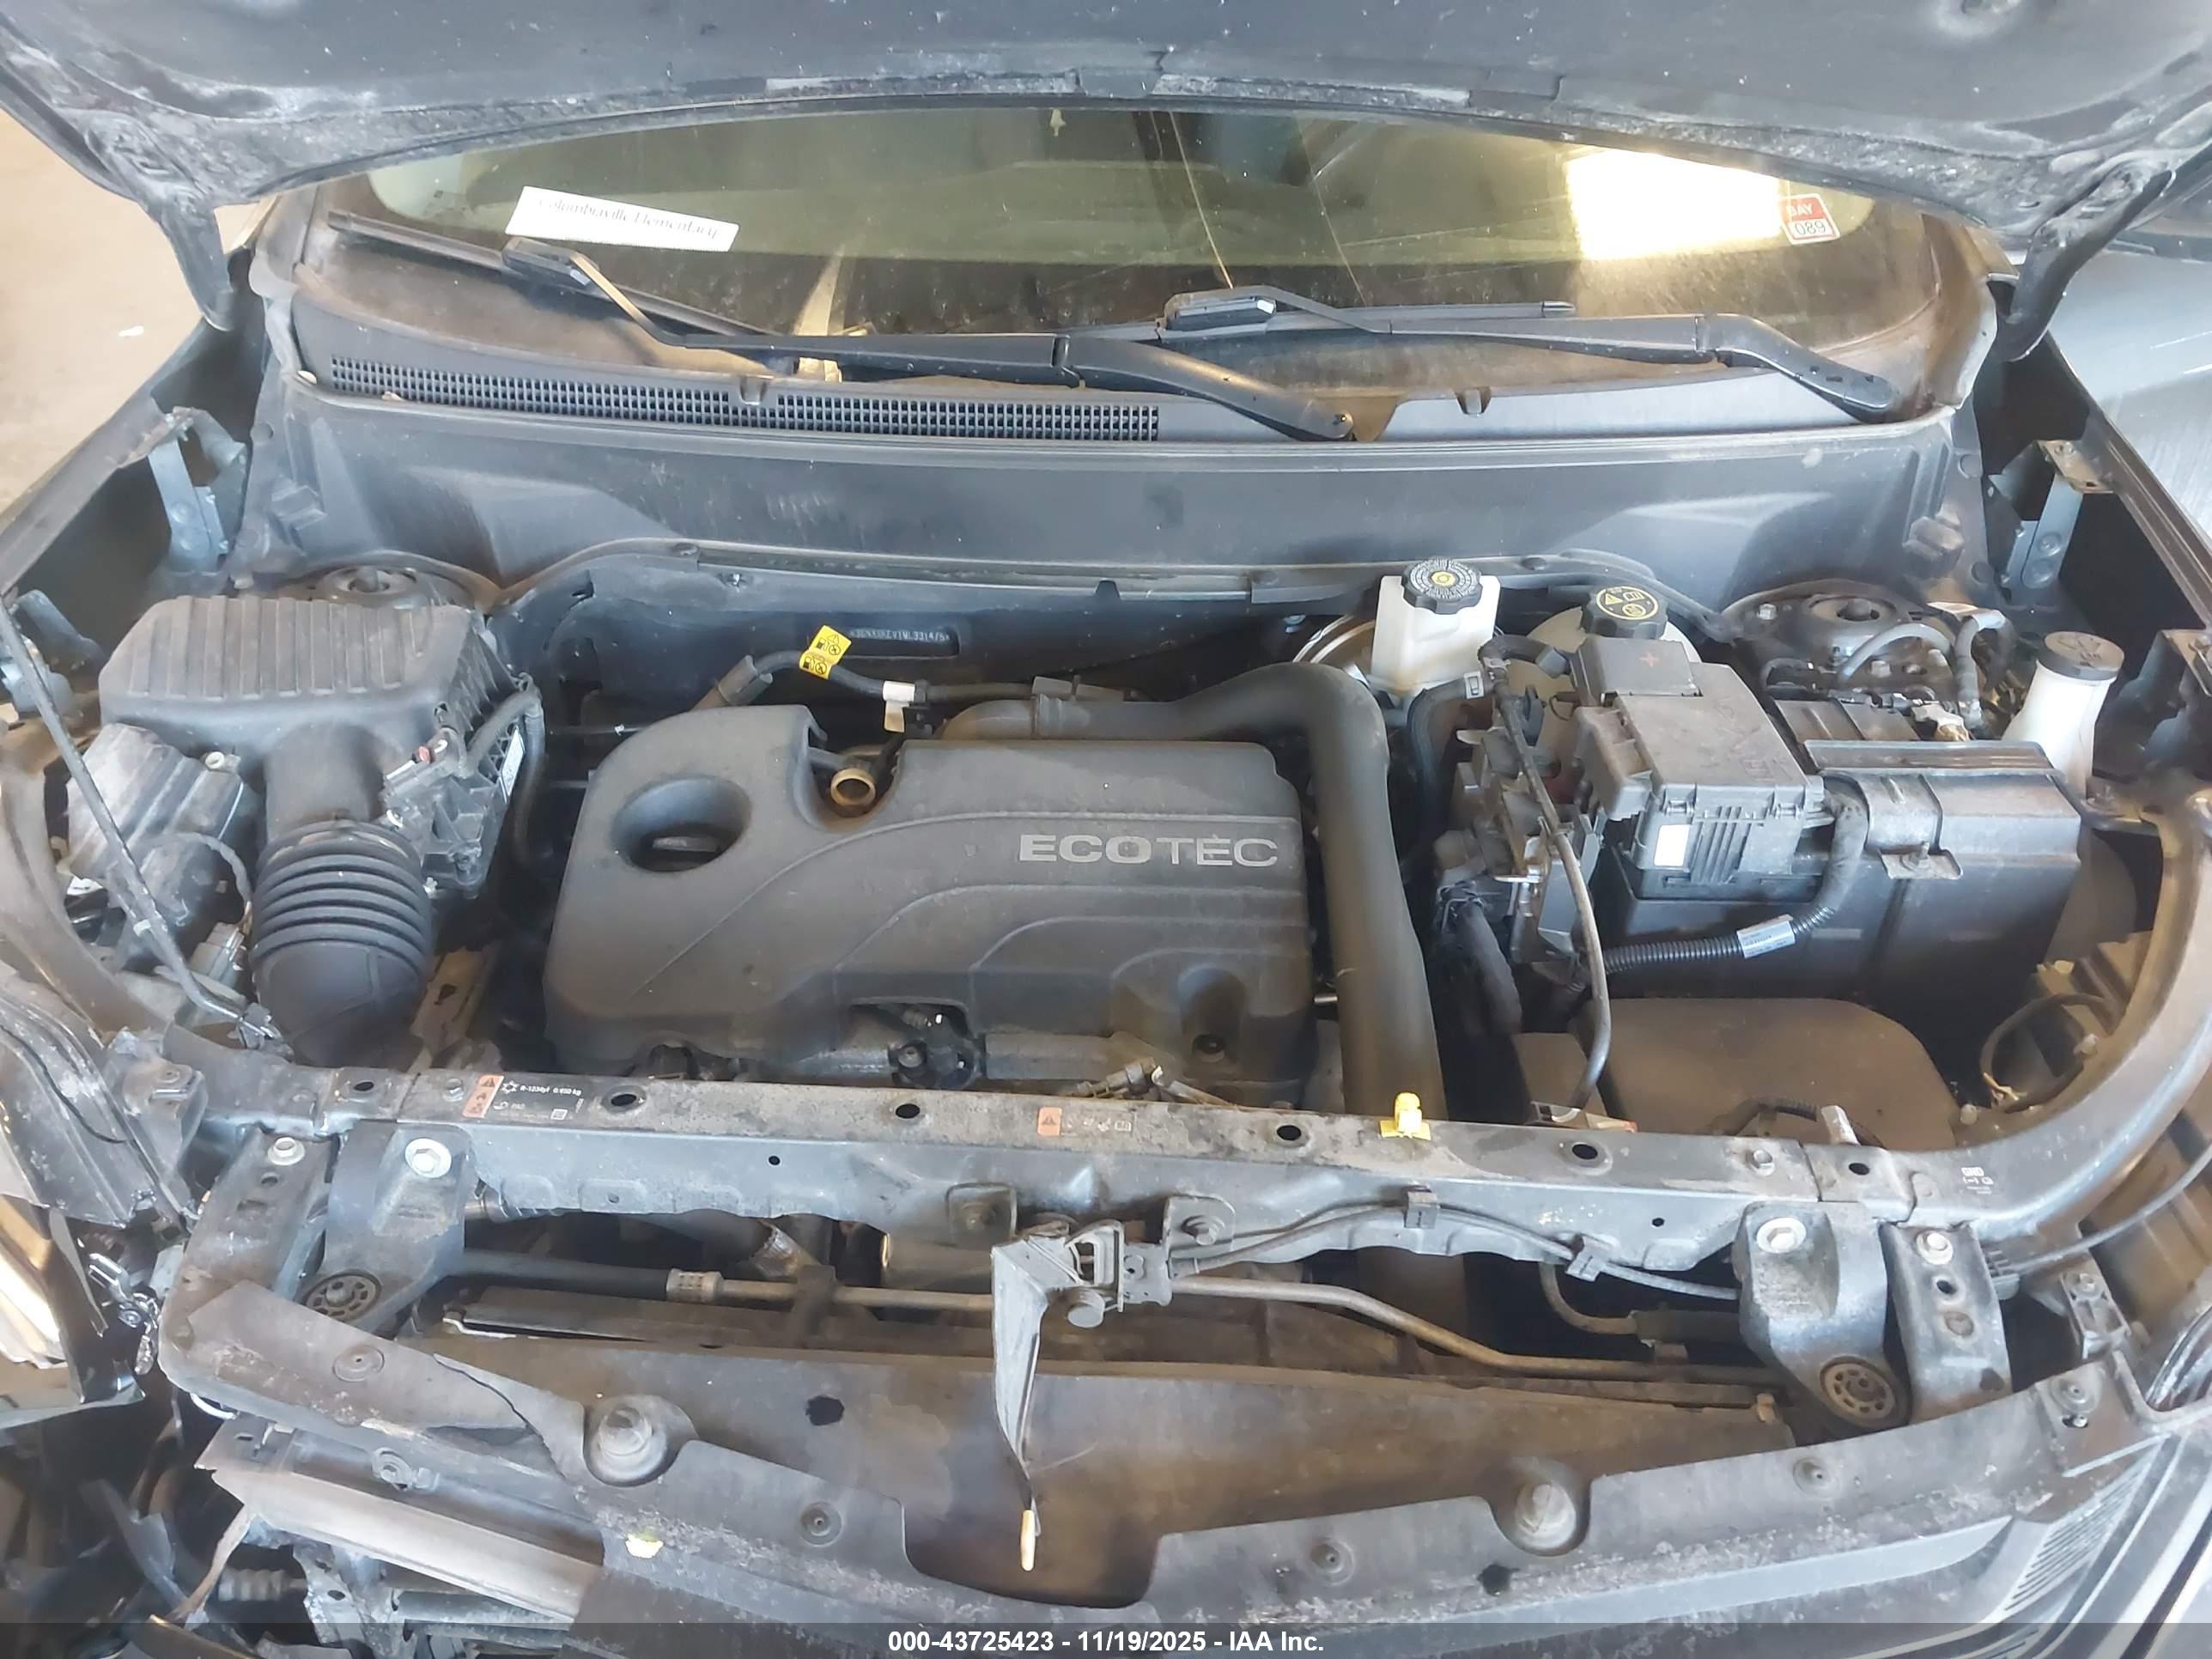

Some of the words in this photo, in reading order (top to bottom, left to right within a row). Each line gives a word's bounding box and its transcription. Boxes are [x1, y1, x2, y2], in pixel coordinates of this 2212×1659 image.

[634, 211, 719, 240] Elementary
[1794, 220, 1826, 235] 089
[1019, 834, 1278, 867] ECOTEC
